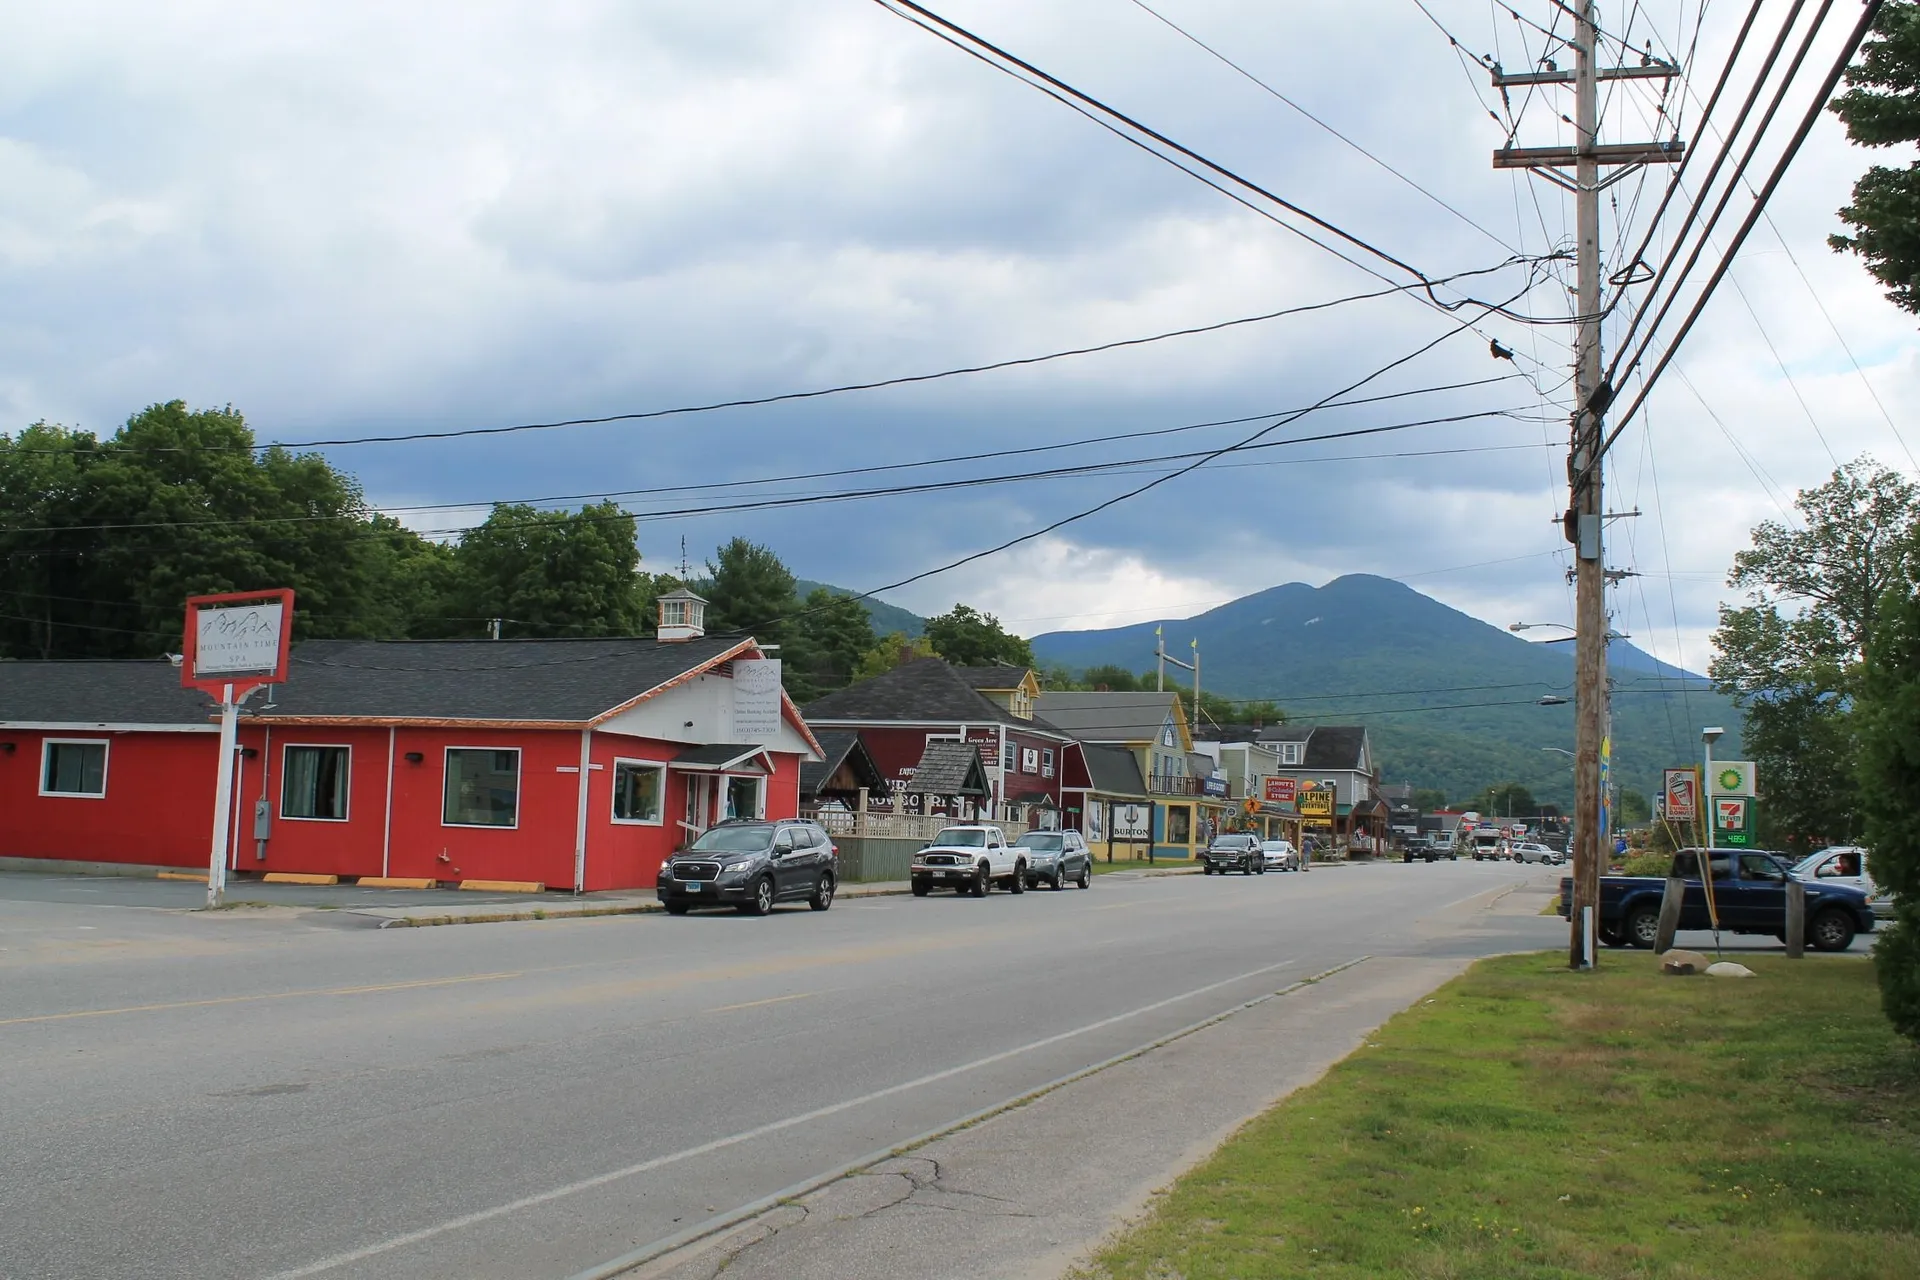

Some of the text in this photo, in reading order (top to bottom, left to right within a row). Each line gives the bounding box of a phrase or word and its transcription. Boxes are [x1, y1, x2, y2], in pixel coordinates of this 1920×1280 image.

[200, 640, 277, 651] MOUNTAIN TIME
[968, 736, 984, 744] Green
[1114, 828, 1149, 836] BURTON
